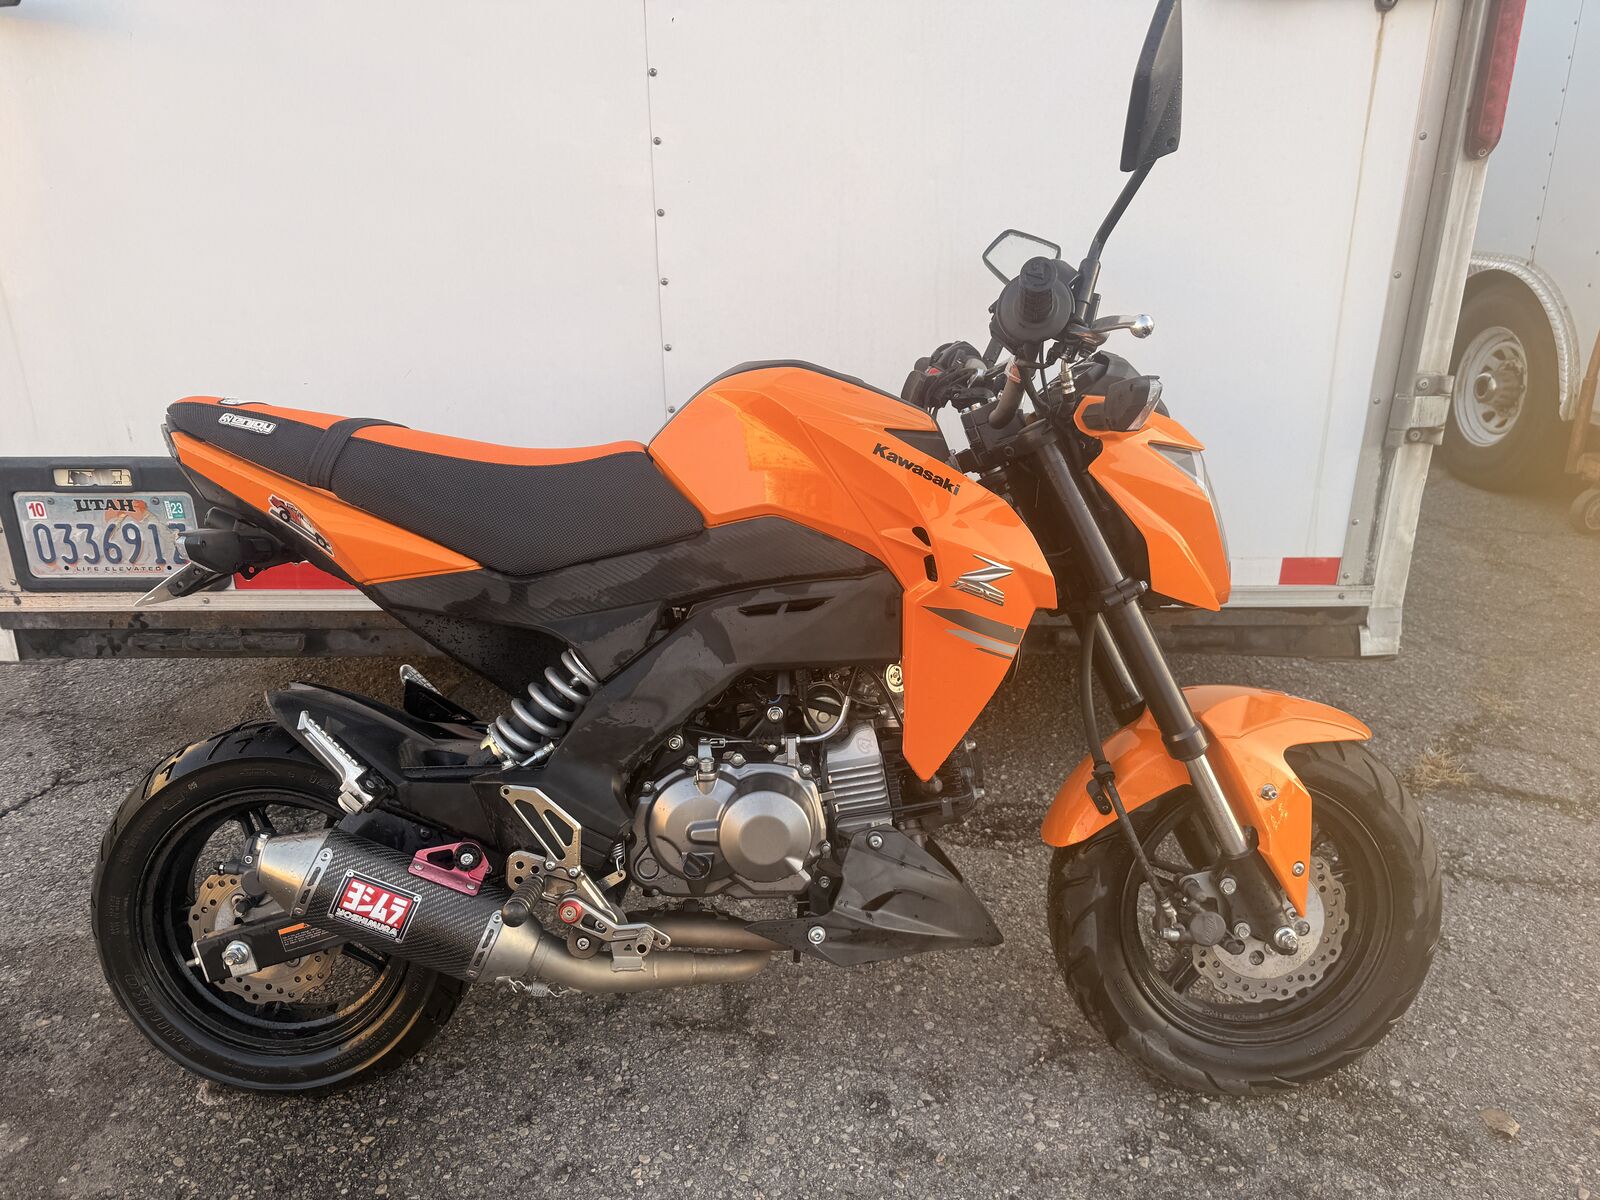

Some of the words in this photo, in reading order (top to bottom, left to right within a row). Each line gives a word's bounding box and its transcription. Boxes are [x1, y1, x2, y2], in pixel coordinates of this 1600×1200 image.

[872, 442, 961, 496] Kawasaki
[28, 502, 46, 517] 10
[73, 499, 137, 512] UTAH
[170, 502, 183, 514] 23
[335, 907, 400, 937] YOSHIMURA
